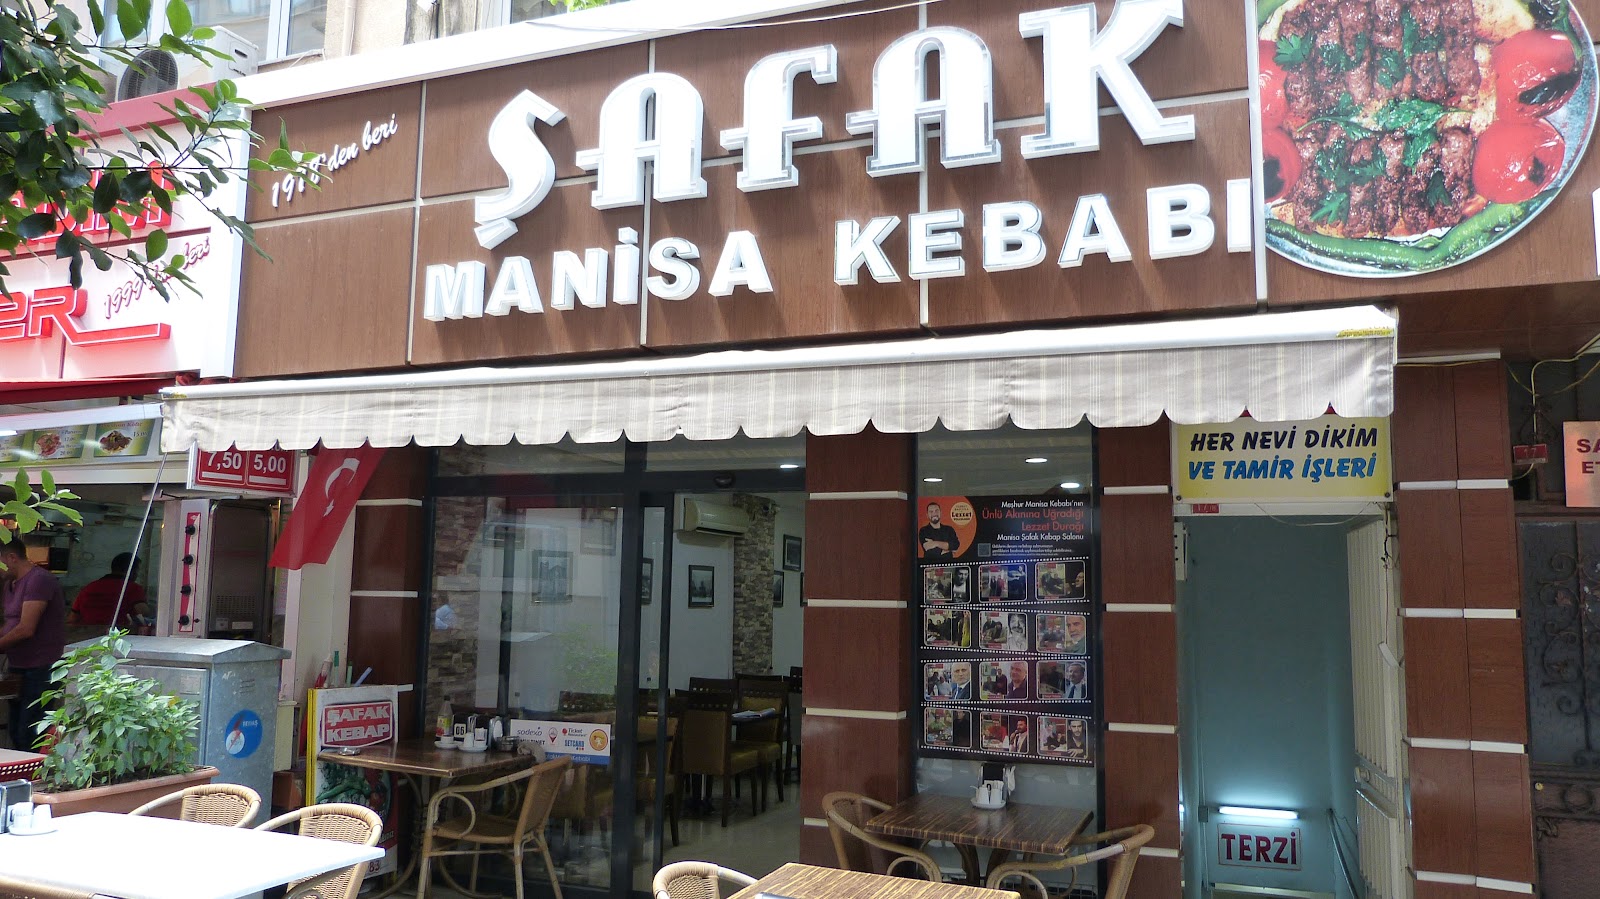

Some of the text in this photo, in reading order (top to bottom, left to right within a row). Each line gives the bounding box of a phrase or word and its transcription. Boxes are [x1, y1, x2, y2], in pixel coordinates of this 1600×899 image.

[362, 113, 399, 152] beri
[474, 0, 1196, 250] ŞAFAK
[833, 178, 1252, 286] KEBABI
[1190, 423, 1378, 452] HER NEVİ DİKİM
[206, 451, 287, 474] 7,50 5,00
[1189, 452, 1377, 483] VE TAMİR İŞLERİ
[982, 508, 1002, 520] Ünlü
[1001, 501, 1024, 509] Meşhur
[1025, 500, 1048, 508] Manisa
[997, 533, 1084, 542] Manisa Şafak Kebap Salonu
[1021, 521, 1084, 532] Lezzet Durağı
[327, 705, 390, 727] ŞAFAK
[326, 723, 390, 743] KEBAP
[517, 726, 543, 737] sodexo
[564, 739, 585, 748] SETCARD
[1221, 831, 1297, 865] TERZİ
